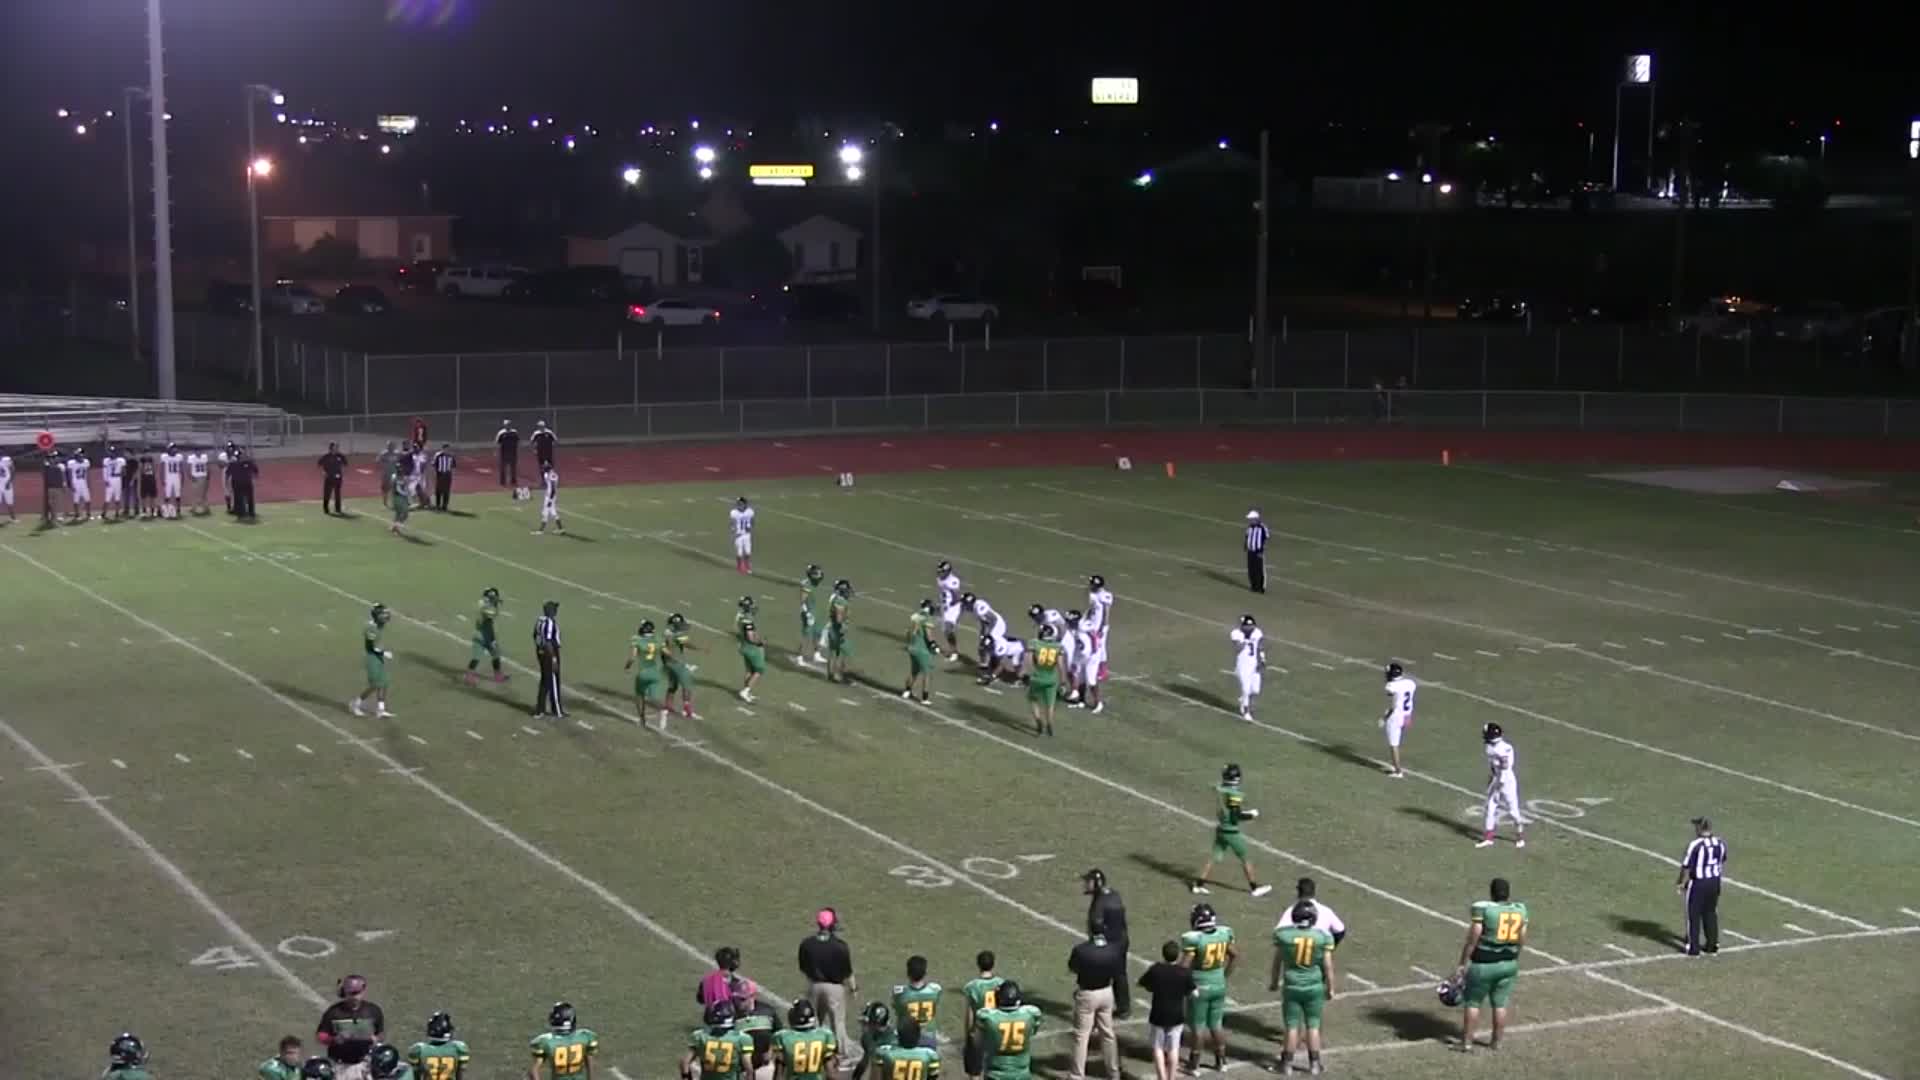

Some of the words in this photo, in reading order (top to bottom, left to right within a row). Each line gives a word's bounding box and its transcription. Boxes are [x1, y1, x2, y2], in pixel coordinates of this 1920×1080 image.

[1402, 691, 1412, 712] 2
[1707, 846, 1719, 865] L
[888, 855, 1020, 888] 30
[1496, 911, 1522, 942] 62
[189, 935, 337, 970] 40
[1200, 941, 1228, 969] 54
[1293, 936, 1314, 967] 71
[998, 1021, 1025, 1051] 75
[704, 1039, 734, 1072] 53
[793, 1039, 823, 1073] 60
[893, 1058, 923, 1080] 50
